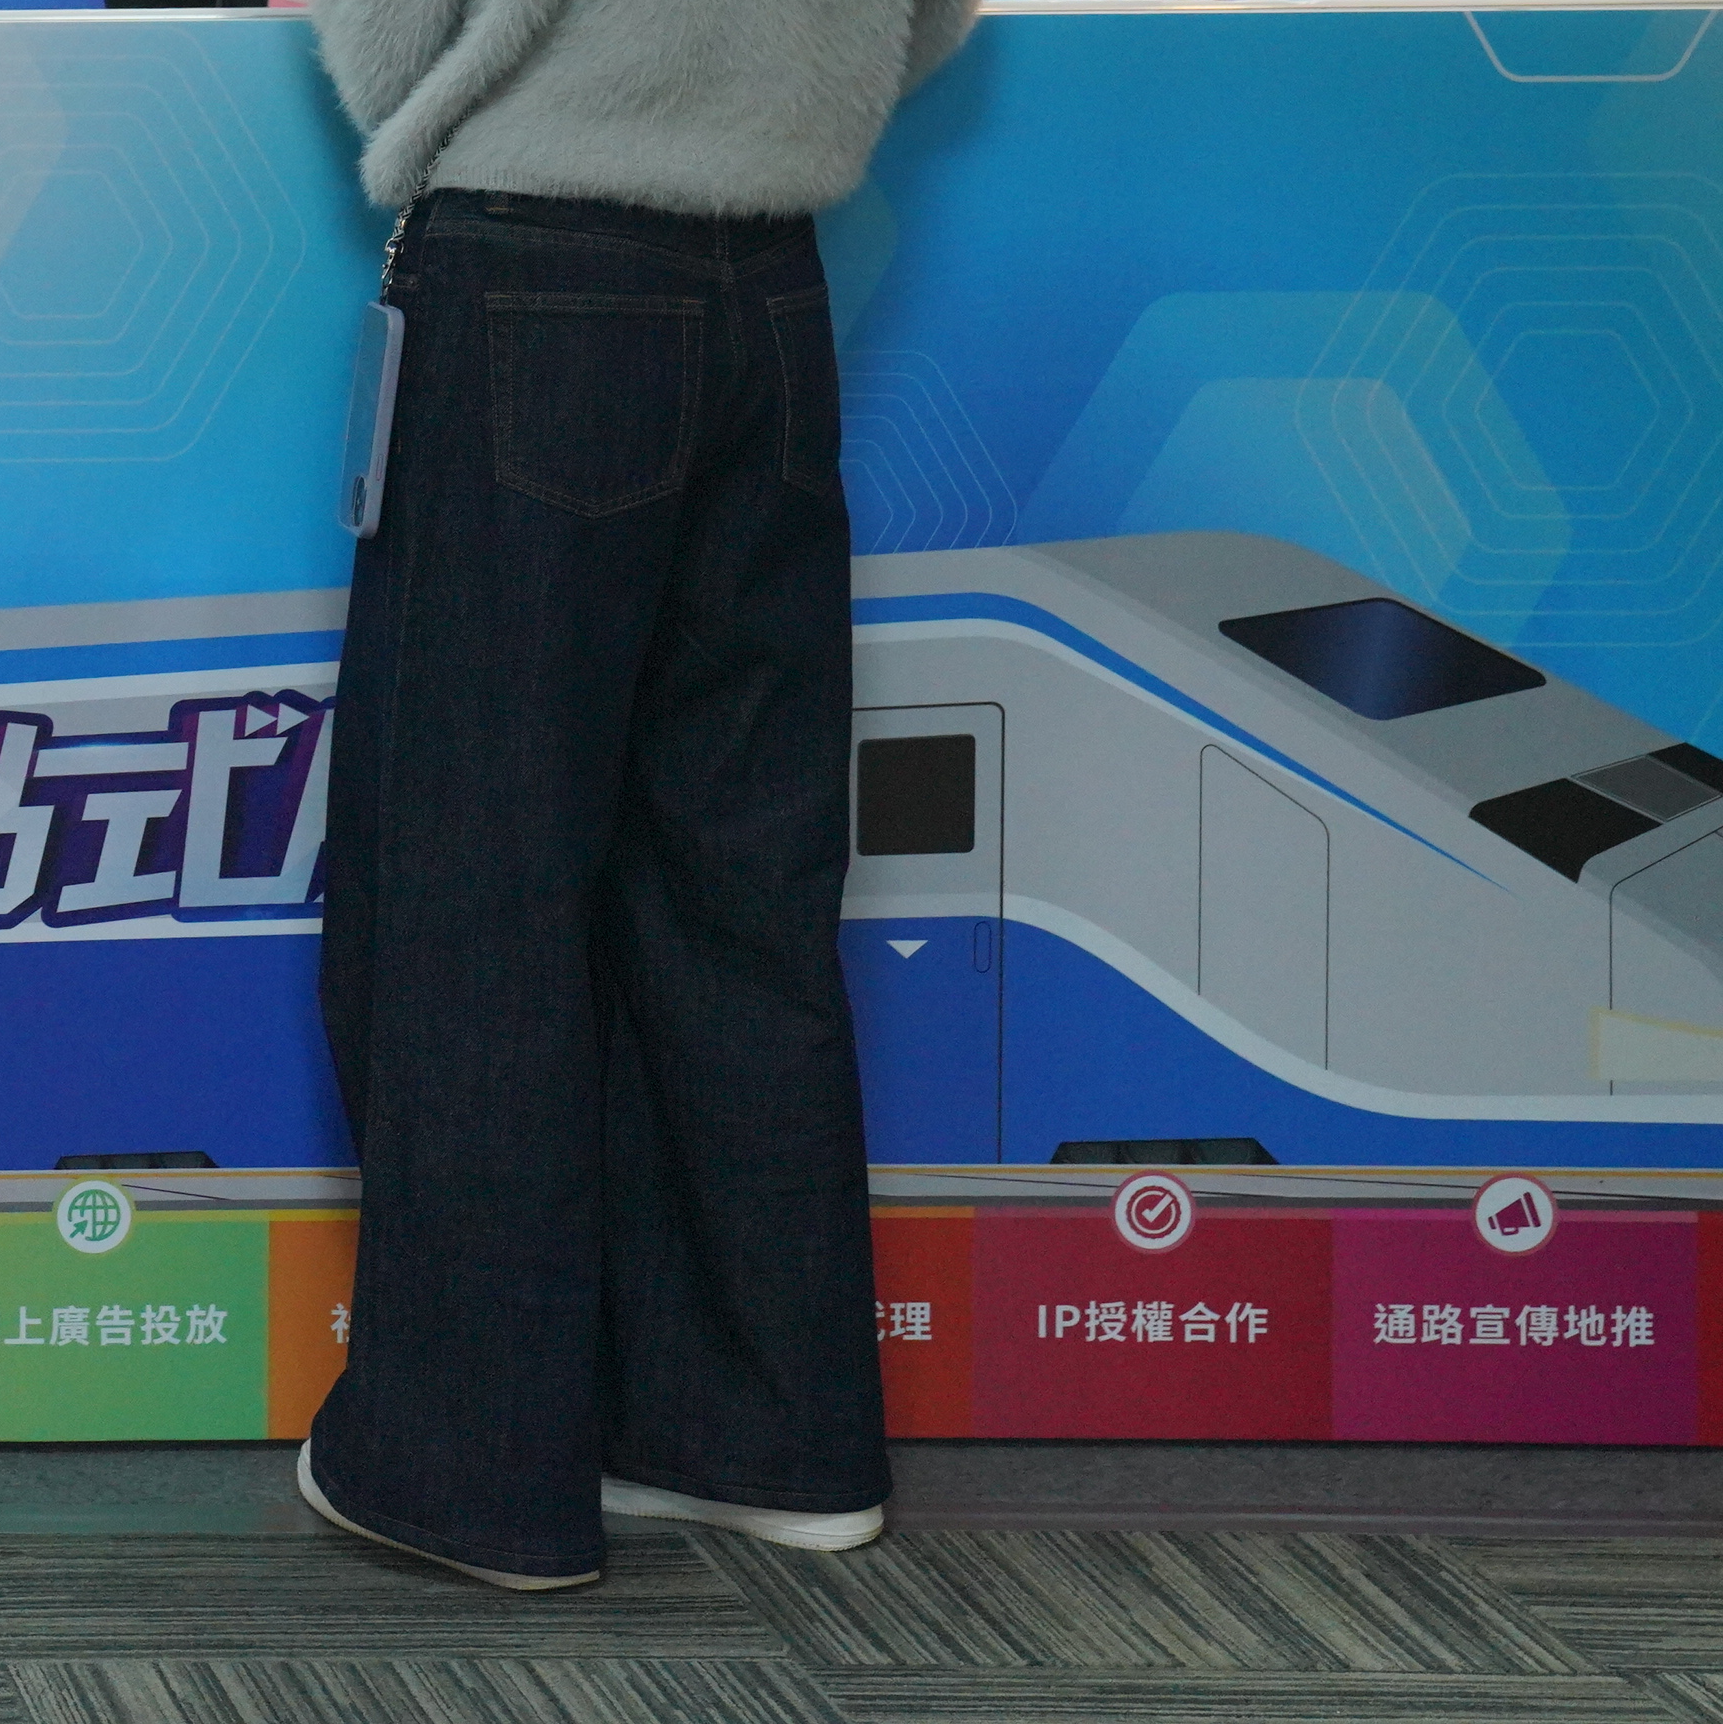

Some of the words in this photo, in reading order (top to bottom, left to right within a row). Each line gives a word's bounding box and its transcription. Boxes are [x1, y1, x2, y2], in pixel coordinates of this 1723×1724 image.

[1036, 1298, 1270, 1345] IP授權合作
[1373, 1302, 1657, 1350] 通路宣傳地推
